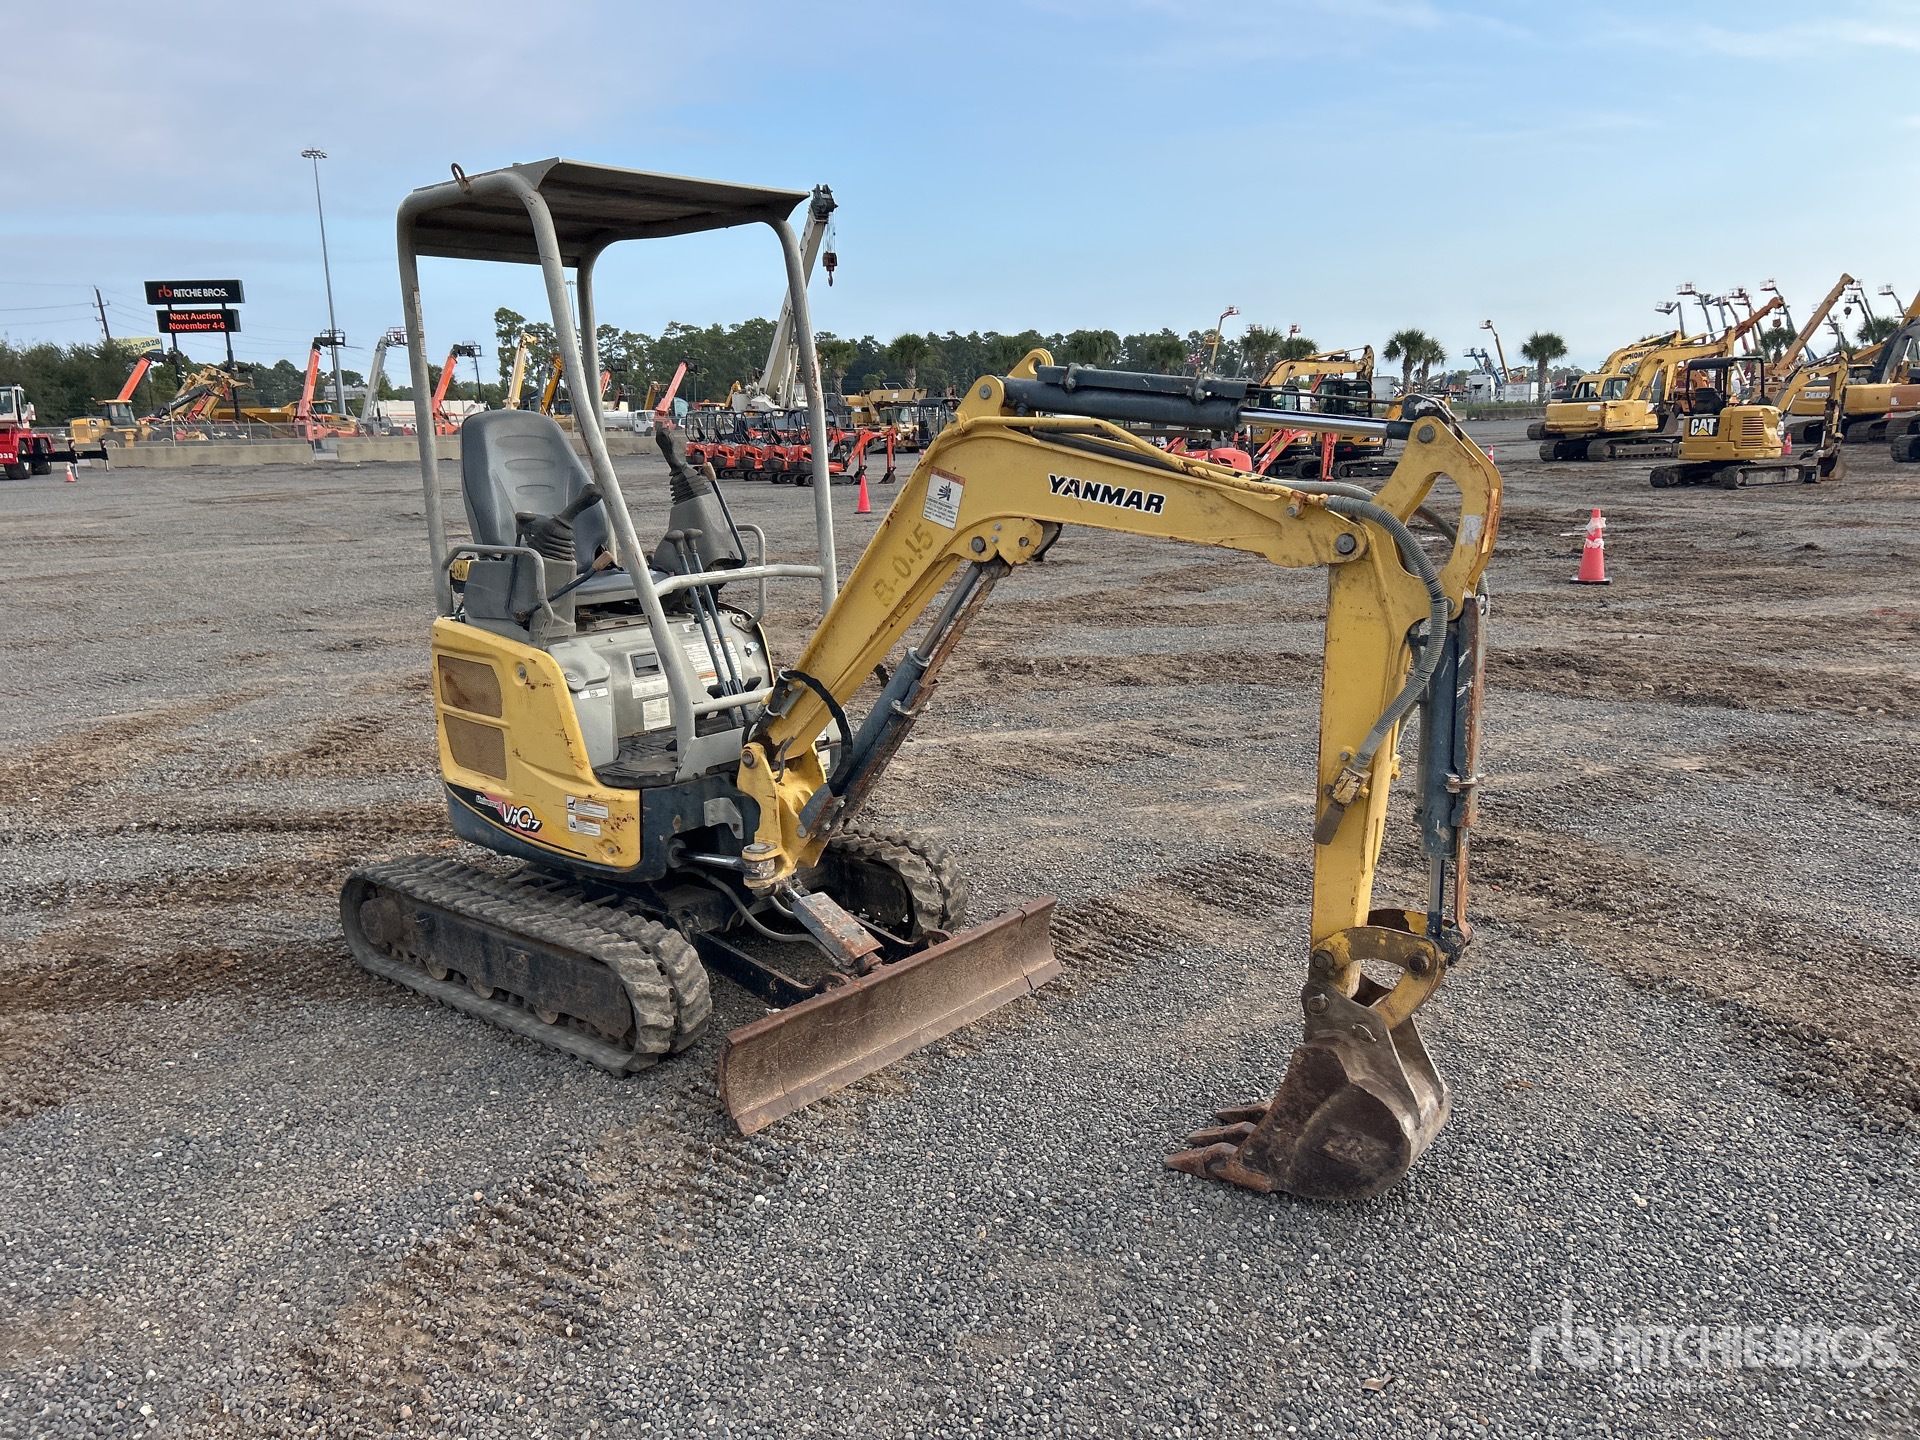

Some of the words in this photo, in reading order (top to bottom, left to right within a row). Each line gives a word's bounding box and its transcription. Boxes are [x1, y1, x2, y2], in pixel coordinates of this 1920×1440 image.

[158, 284, 172, 298] rb
[173, 288, 202, 298] RITCHIE
[203, 287, 229, 298] BROS.
[169, 313, 189, 321] Next
[190, 312, 222, 321] Auction
[168, 322, 210, 331] November
[1804, 391, 1830, 399] DEER
[1690, 418, 1716, 435] CAT
[1048, 473, 1167, 515] YANMAR
